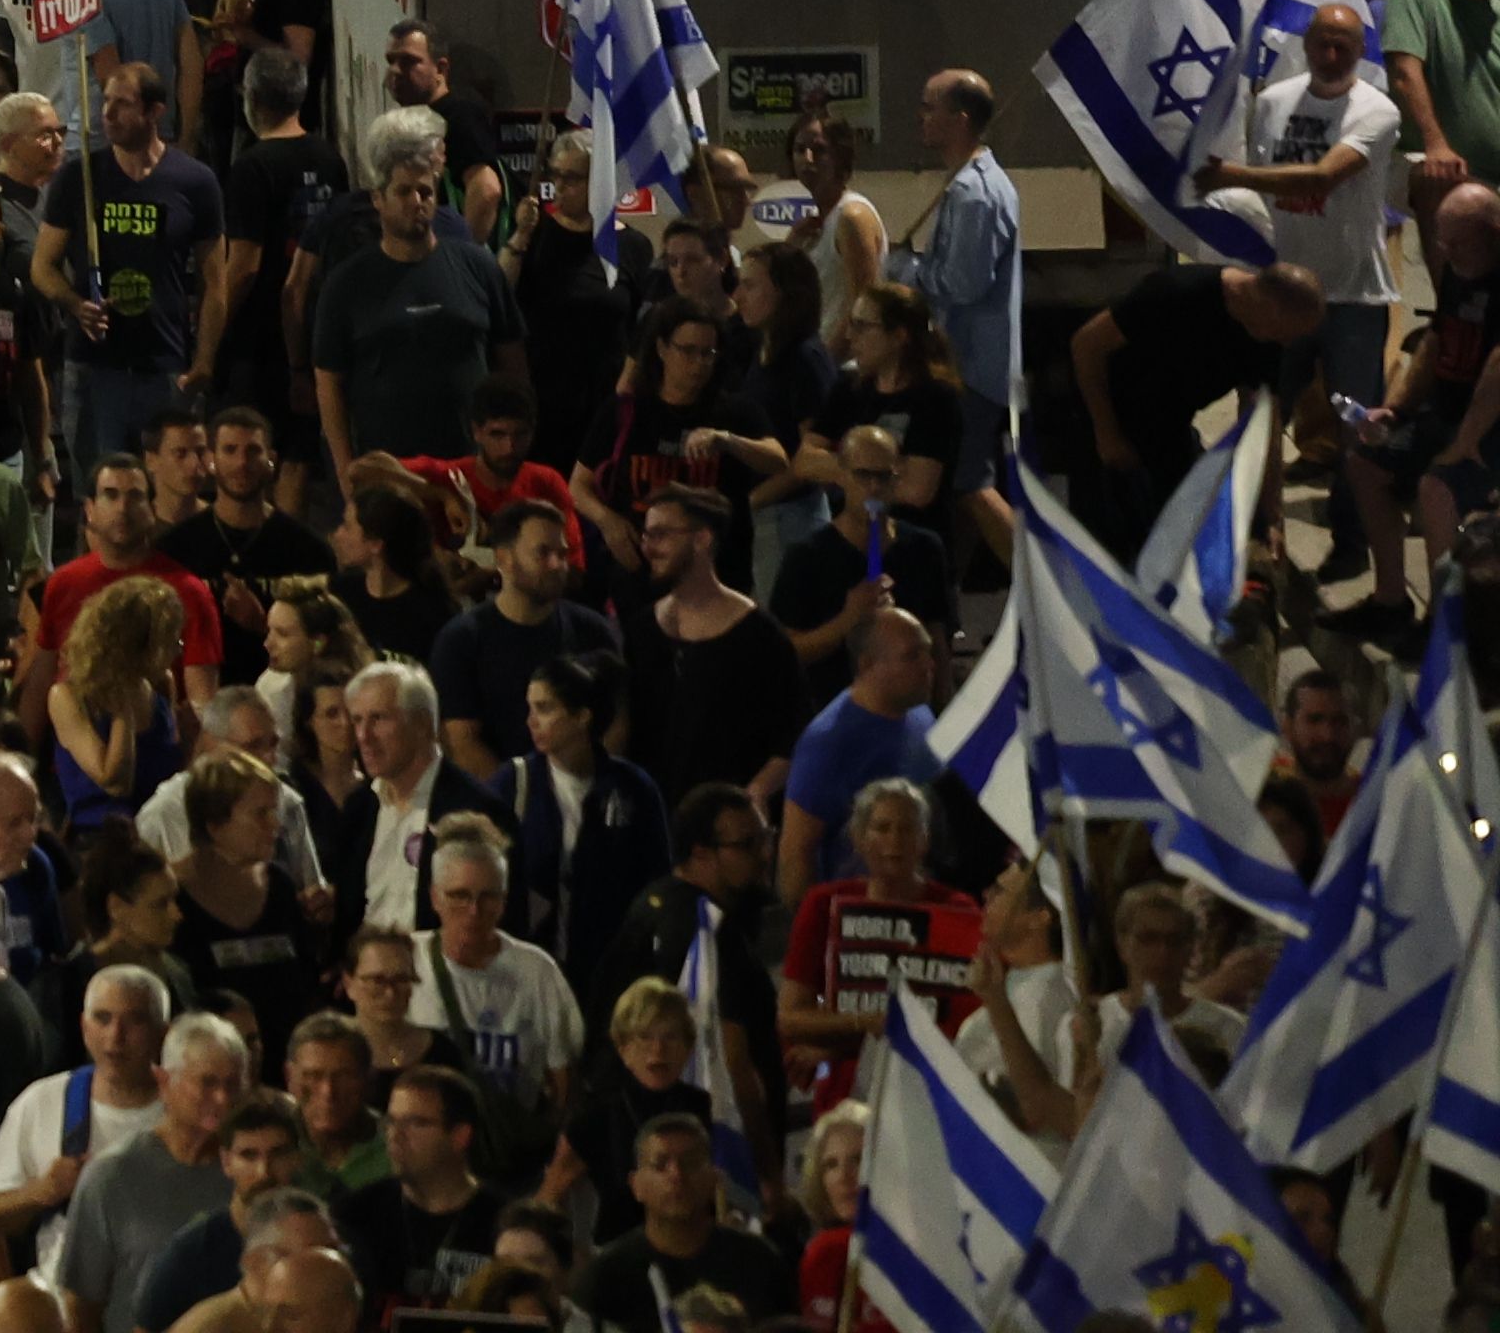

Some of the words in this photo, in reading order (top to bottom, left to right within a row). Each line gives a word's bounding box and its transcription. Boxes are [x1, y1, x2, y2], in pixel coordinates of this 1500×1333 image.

[103, 203, 157, 217] הדחה
[103, 218, 157, 236] עכשיו
[839, 952, 889, 977] YOUR
